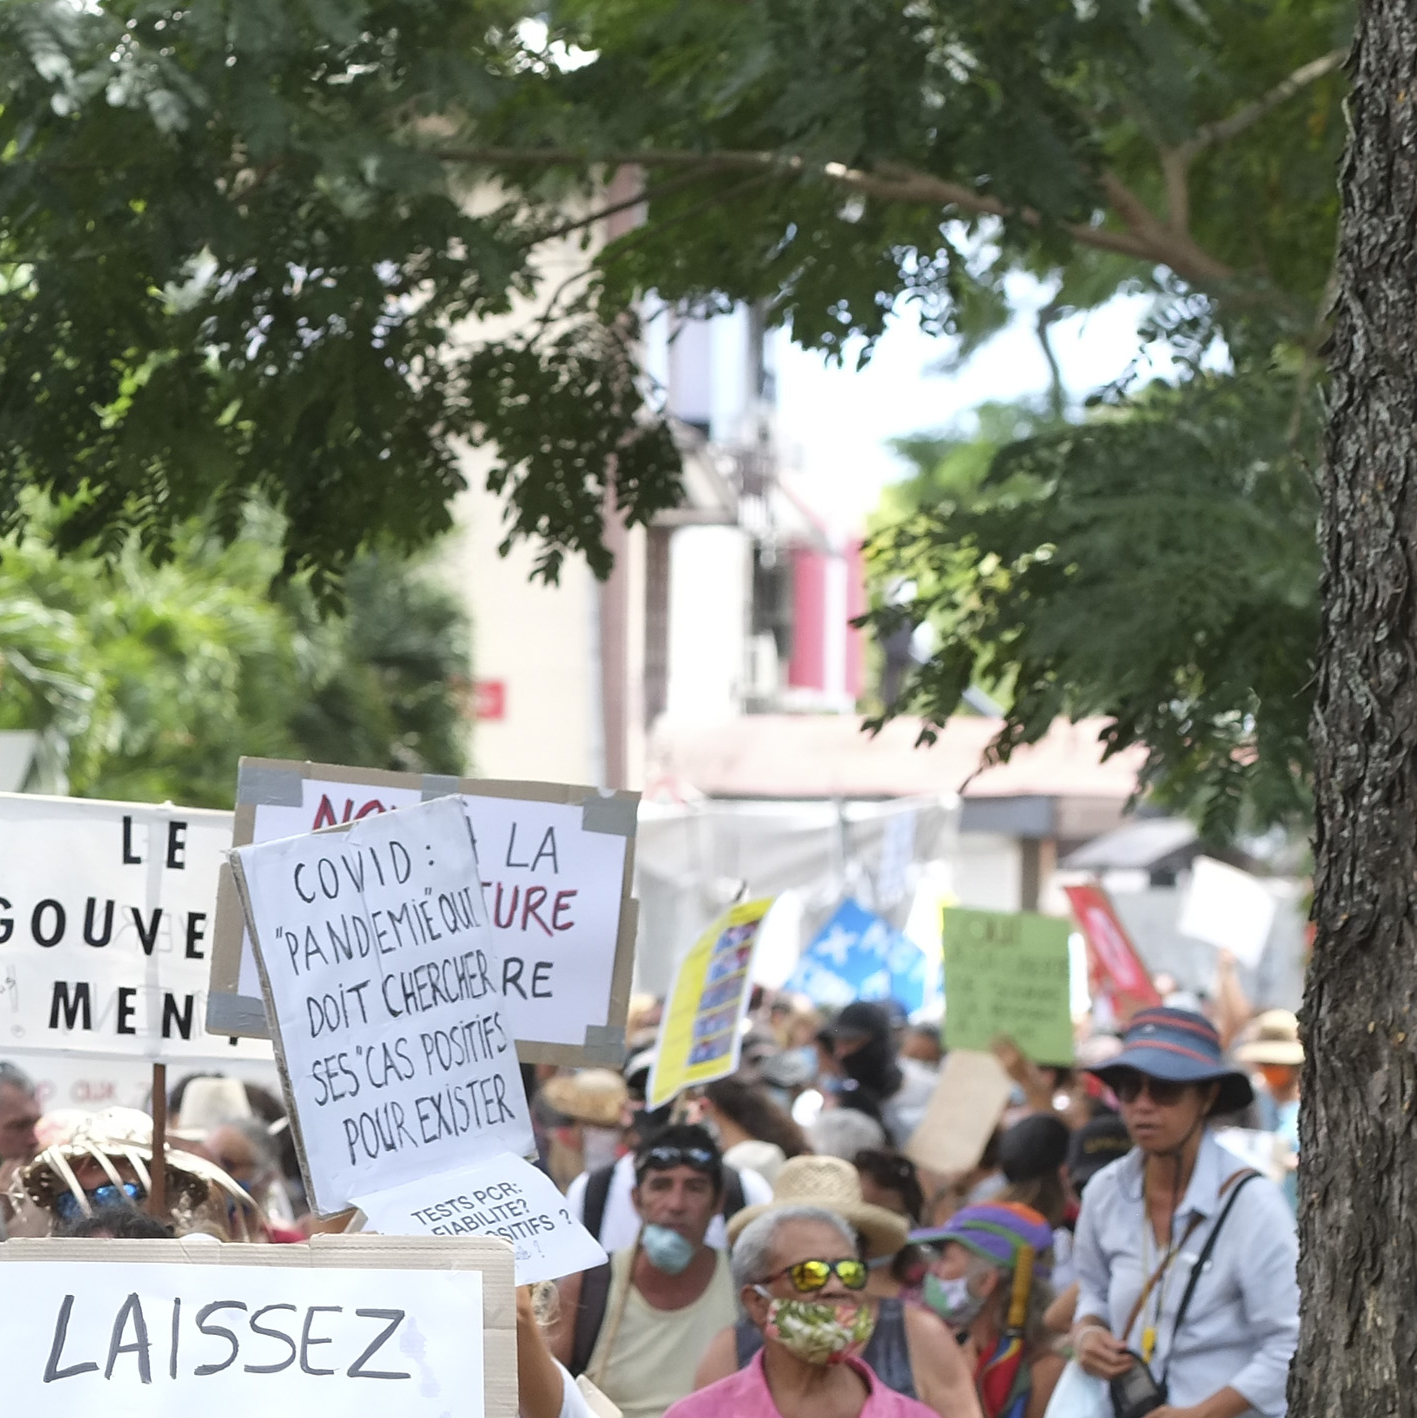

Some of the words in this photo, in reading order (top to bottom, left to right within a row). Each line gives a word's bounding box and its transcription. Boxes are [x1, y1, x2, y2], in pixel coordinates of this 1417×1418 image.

[122, 814, 187, 870] LE
[505, 822, 558, 874] LA
[49, 981, 237, 1046] MEN
[382, 950, 497, 1018] CHERCHER
[307, 1052, 360, 1107] SES
[420, 1011, 508, 1076] POSITIFS
[343, 1101, 418, 1166] POUR
[415, 1074, 516, 1144] EXISTER
[410, 1195, 475, 1226] TESTS
[472, 1181, 522, 1205] PCR:
[431, 1198, 531, 1236] FIABILITE?
[43, 1291, 411, 1385] LAISSEZ
